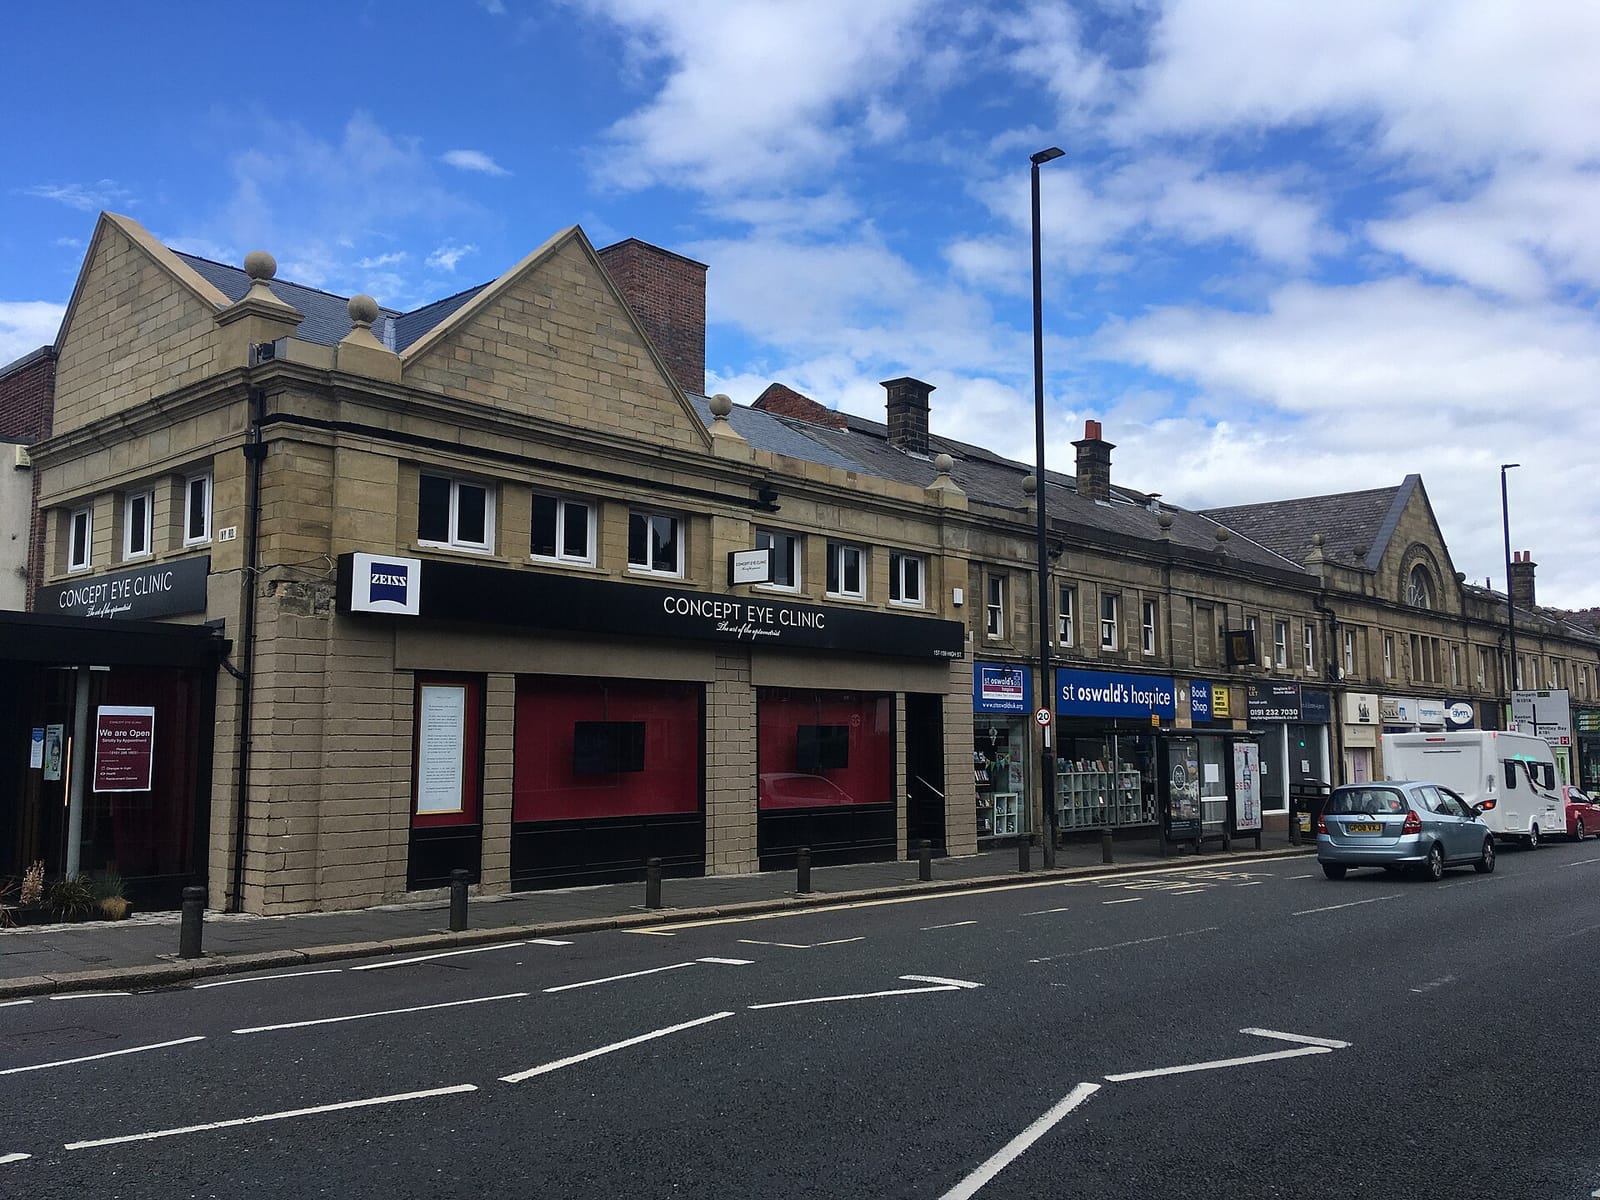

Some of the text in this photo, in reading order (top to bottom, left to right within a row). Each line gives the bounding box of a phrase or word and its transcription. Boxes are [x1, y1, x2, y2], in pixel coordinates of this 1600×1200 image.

[371, 573, 407, 587] ZEISS
[59, 571, 173, 609] CONCEPT EYE CLINIC
[663, 596, 825, 629] CONCEPT EYE CLINIC
[716, 620, 729, 632] The
[1062, 683, 1171, 710] st oswald's hospice
[1191, 686, 1207, 698] Book
[1192, 699, 1208, 714] Shop
[1037, 712, 1050, 721] 20
[1452, 710, 1468, 718] gym
[99, 729, 113, 737] We
[129, 729, 150, 738] Open
